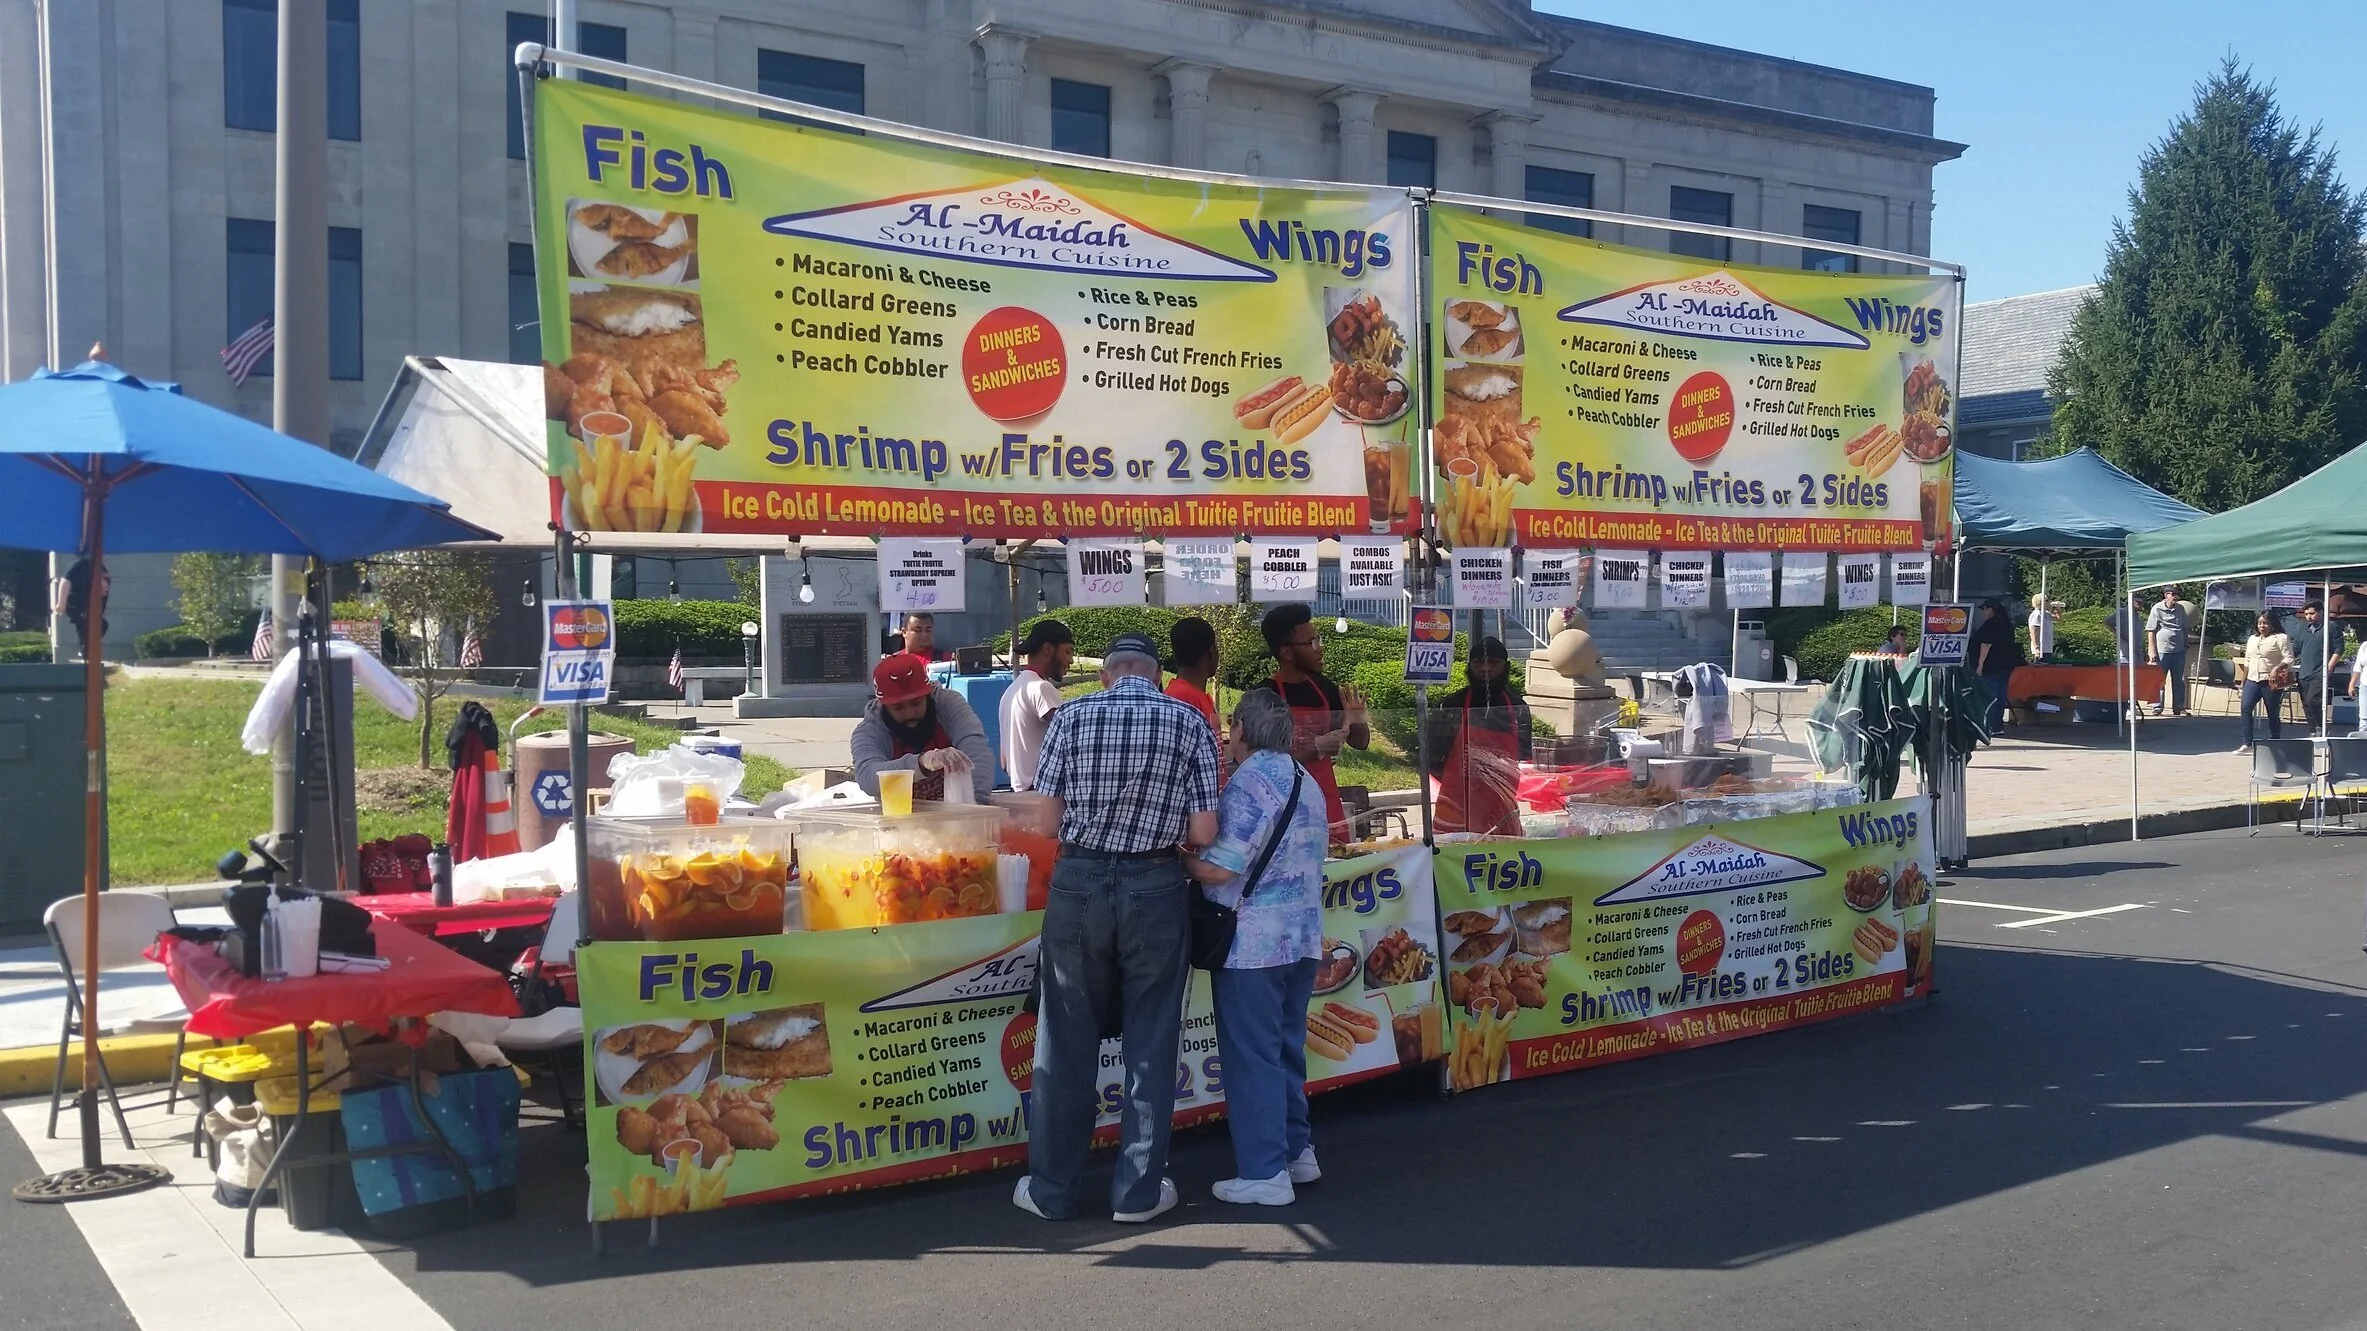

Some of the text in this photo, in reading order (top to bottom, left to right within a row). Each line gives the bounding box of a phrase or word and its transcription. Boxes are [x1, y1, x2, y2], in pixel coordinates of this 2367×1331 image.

[582, 124, 733, 200] Fish
[878, 226, 1171, 270] Southern Cuisine
[1239, 218, 1391, 282] Wings
[793, 253, 991, 293] Macaroni & Cheese
[1456, 240, 1544, 296] Fish
[792, 286, 957, 318] Collard Greens
[1091, 288, 1198, 308] Rice & Peas
[791, 318, 944, 348] Candied Yams
[1097, 314, 1195, 337] Corn Bread
[1627, 310, 1806, 339] Southern Cuisine
[1844, 297, 1944, 345] Wings
[979, 325, 1041, 352] DINNERS
[1571, 335, 1697, 361] Macaroni & Cheese
[792, 350, 948, 378] Peach Cobbler
[1007, 348, 1018, 366] &
[1096, 341, 1283, 370] Fresh Cut French Fries
[971, 358, 1060, 393] SANDWICHES
[1095, 371, 1230, 397] Grilled Hot Dogs
[1577, 406, 1660, 429] Peach Cobbler
[765, 419, 948, 484] Shrimp
[1126, 456, 1154, 479] or
[1165, 440, 1190, 479] 2
[1202, 440, 1313, 480] Sides
[1556, 461, 1667, 508] Shrimp
[1772, 489, 1791, 505] or
[1798, 474, 1816, 505] 2
[1822, 473, 1888, 507] Sides
[723, 488, 1356, 533] Ice Cold Lemonade Ice Tea & the Original Tuitie Fruitie Blend
[1529, 514, 1913, 548] Ice Cold Lemonade Ice Tea & the Original Tuitie Fruitie Blend
[1079, 550, 1132, 575] WINGS
[1268, 548, 1300, 558] PEACH
[1353, 547, 1390, 557] COMBOS
[1460, 559, 1502, 568] CHICKEN
[1542, 560, 1562, 569] FISH
[1263, 562, 1307, 572] COBBLER
[1350, 561, 1393, 570] AVAILABLE
[1461, 571, 1502, 581] DINNERS
[1532, 572, 1570, 582] DINNERS
[1602, 560, 1640, 581] SHRIMPS
[1669, 562, 1704, 570] CHICKEN
[1669, 573, 1703, 582] DINNERS
[1845, 563, 1874, 583] WINGS
[1897, 573, 1925, 581] DINNERS
[1898, 562, 1924, 570] SHRIMP
[911, 579, 936, 587] UPTOWN
[1349, 573, 1393, 586] JUST ASK!
[554, 622, 608, 634] MasterCard
[1414, 621, 1450, 630] MasterCard
[1928, 617, 1966, 625] MasterCard
[1415, 651, 1447, 667] VISA
[1929, 641, 1961, 654] VISA
[556, 661, 604, 683] VISA
[1838, 810, 1918, 850] Wings
[1463, 850, 1544, 894] Fish
[1647, 868, 1784, 895] Southern Cuisine
[639, 949, 774, 1002] Fish
[1560, 984, 1652, 1025] Shrimp
[1753, 975, 1769, 992] or
[1774, 957, 1789, 988] 2
[1795, 950, 1854, 984] Sides
[865, 1005, 1016, 1038] Macaroni & Cheese
[1186, 1012, 1215, 1029] ench
[1526, 980, 1894, 1069] Ice Cold Lemonade Ice Tea & the Original Tuitie Fruitie Blend
[869, 1031, 986, 1062] Collard Greens
[1184, 1037, 1217, 1053] Dogs
[872, 1056, 982, 1087] Candied Yams
[1175, 1062, 1194, 1100] 2
[872, 1078, 989, 1110] Peach Cobbler
[803, 1112, 976, 1169] Shrimp
